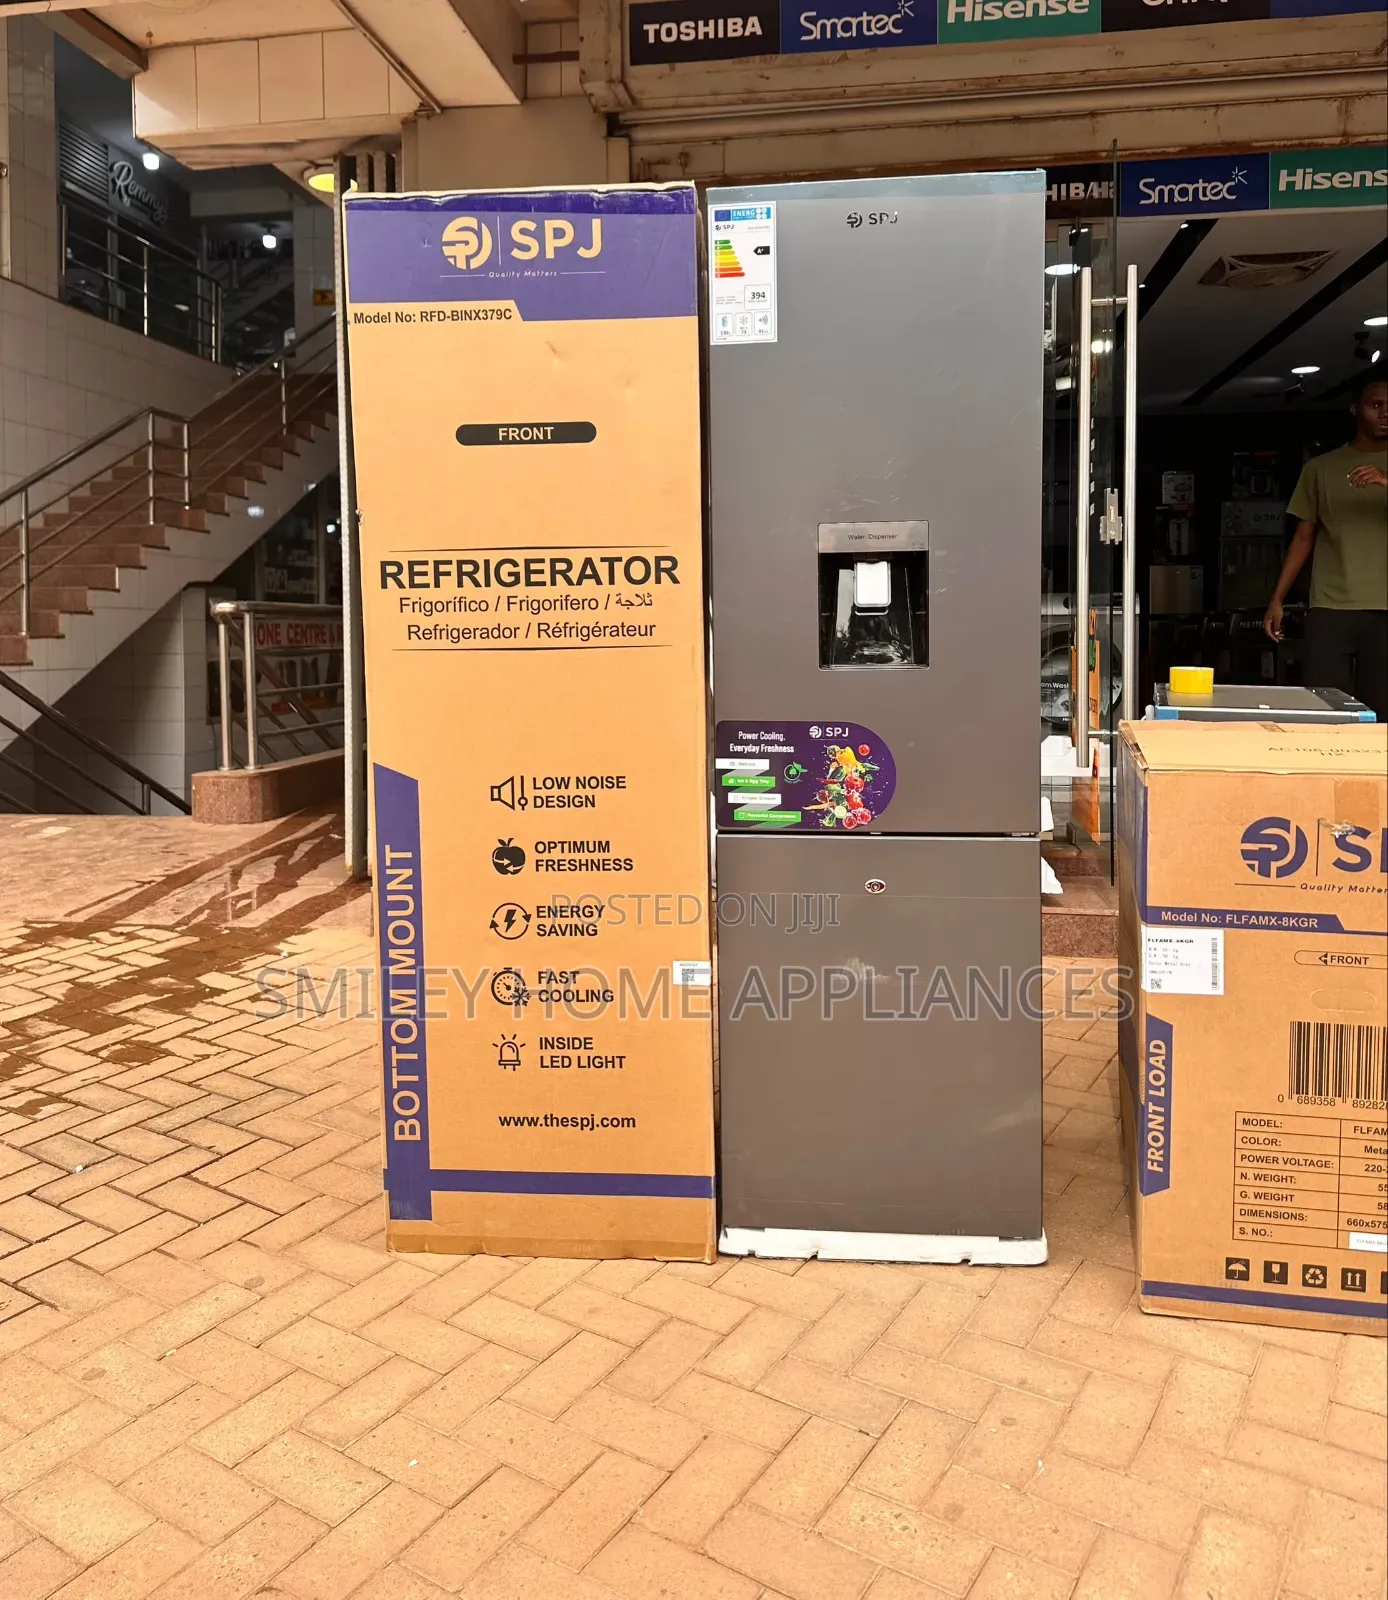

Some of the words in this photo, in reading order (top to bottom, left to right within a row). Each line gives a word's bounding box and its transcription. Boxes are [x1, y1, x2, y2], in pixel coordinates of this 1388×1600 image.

[947, 0, 1090, 23] Hisense
[643, 15, 763, 44] TOSHIBA
[800, 9, 905, 41] Smartec
[1138, 177, 1237, 205] Smartec
[868, 211, 898, 225] SPJ
[510, 217, 602, 260] SPJ
[750, 291, 766, 300] 394
[353, 311, 391, 324] Model
[394, 311, 416, 323] No:
[420, 308, 513, 322] RFD-BINX379C
[498, 426, 554, 441] FRONT
[380, 555, 680, 590] REFRIGERATOR
[399, 596, 489, 617] Frigorífico
[506, 594, 599, 615] Frigorifero
[615, 593, 653, 611] ثلاجة
[287, 622, 327, 645] CENTRE
[407, 623, 520, 643] Refrigerador
[537, 622, 656, 642] Réfrigérateur
[738, 731, 758, 740] Power
[826, 727, 849, 737] SPJ
[729, 743, 760, 754] Everyday
[760, 744, 795, 753] Freshness
[533, 776, 571, 790] LOW
[575, 776, 627, 789] NOISE
[533, 795, 596, 808] DESIGN
[534, 840, 610, 854] OPTIMUM
[535, 858, 634, 872] FRESHNESS
[1300, 882, 1343, 893] Quality
[385, 844, 416, 975] MOUNT
[536, 904, 606, 919] ENERGY
[1161, 910, 1197, 922] Model
[1201, 913, 1222, 923] No:
[1226, 914, 1318, 928] FLFAMX-8KGR
[536, 923, 598, 937] SAVING
[1330, 954, 1370, 965] FRONT
[538, 970, 580, 984] FAST
[538, 989, 614, 1003] COOLING
[539, 1037, 594, 1050] INSIDE
[390, 989, 421, 1141] BOTTOM
[540, 1055, 572, 1069] LED
[577, 1055, 626, 1069] LIGHT
[1149, 1039, 1166, 1097] LOAD
[1296, 1095, 1336, 1107] 689358
[498, 1113, 636, 1131] www.thespj.com
[1242, 1117, 1283, 1128] MODEL:
[1147, 1102, 1165, 1173] FRONT
[1240, 1136, 1281, 1146] COLOR:
[1240, 1154, 1279, 1164] POWER
[1282, 1157, 1334, 1168] VOLTAGE:
[1240, 1172, 1250, 1180] N.
[1253, 1173, 1296, 1184] WEIGHT:
[1240, 1190, 1250, 1199] G.
[1253, 1191, 1295, 1202] WEIGHT
[1239, 1208, 1307, 1221] DIMENSIONS:
[1239, 1226, 1249, 1235] S.
[1251, 1228, 1273, 1237] NO.:
